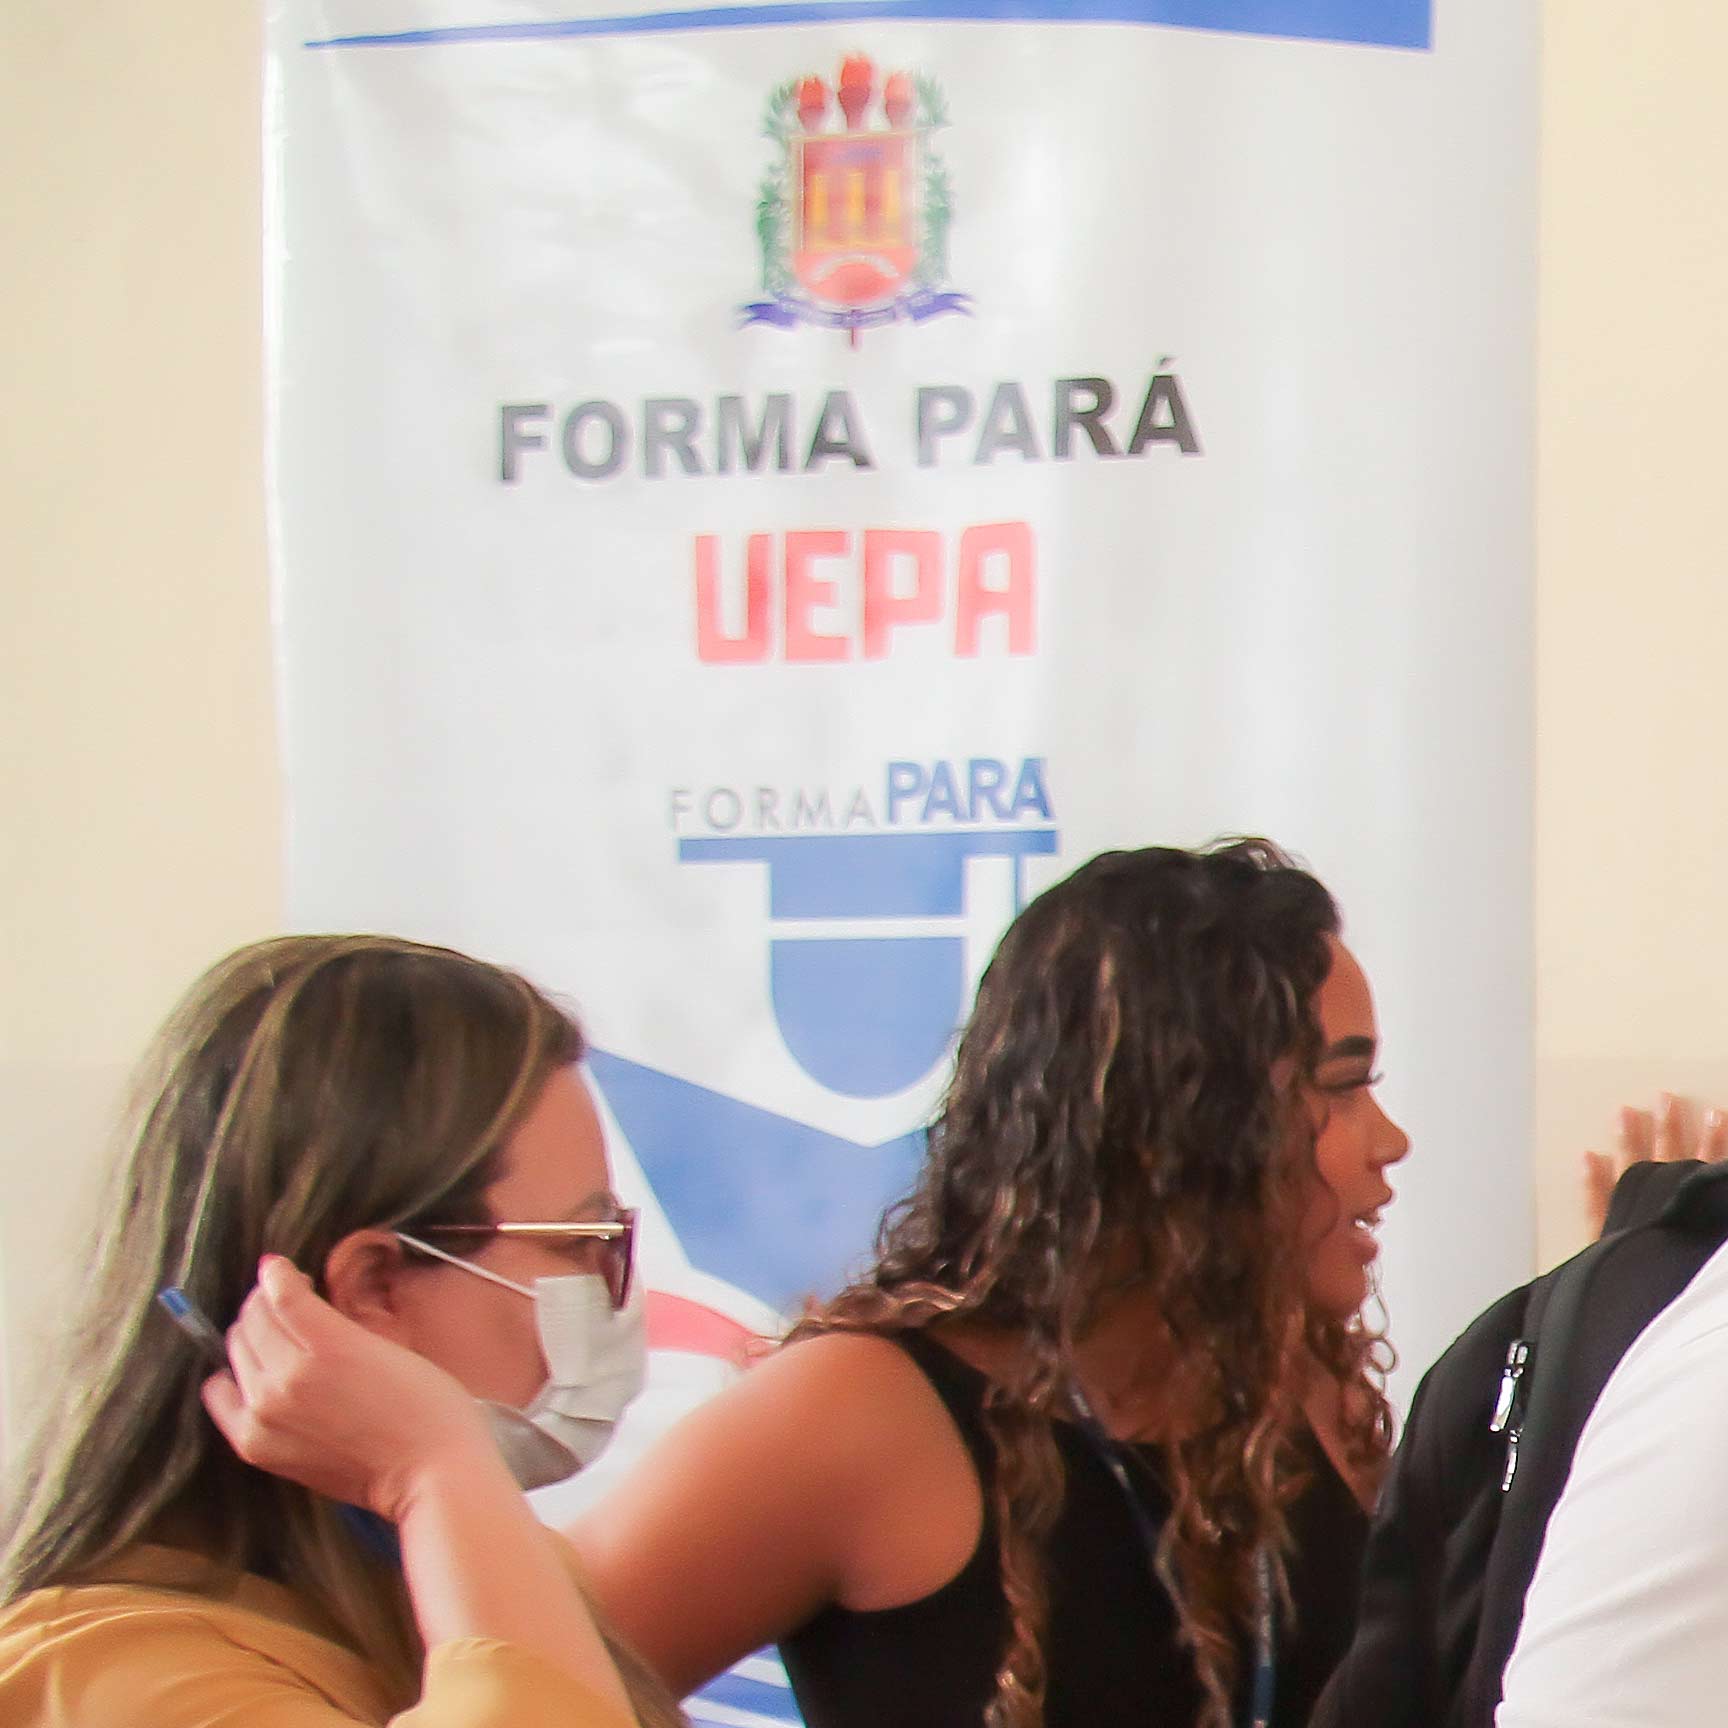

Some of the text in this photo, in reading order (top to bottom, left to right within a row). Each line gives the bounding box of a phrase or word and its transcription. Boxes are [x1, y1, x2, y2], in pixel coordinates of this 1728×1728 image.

[498, 356, 1202, 483] FORMA PARÁ
[694, 520, 1039, 665] UEPA
